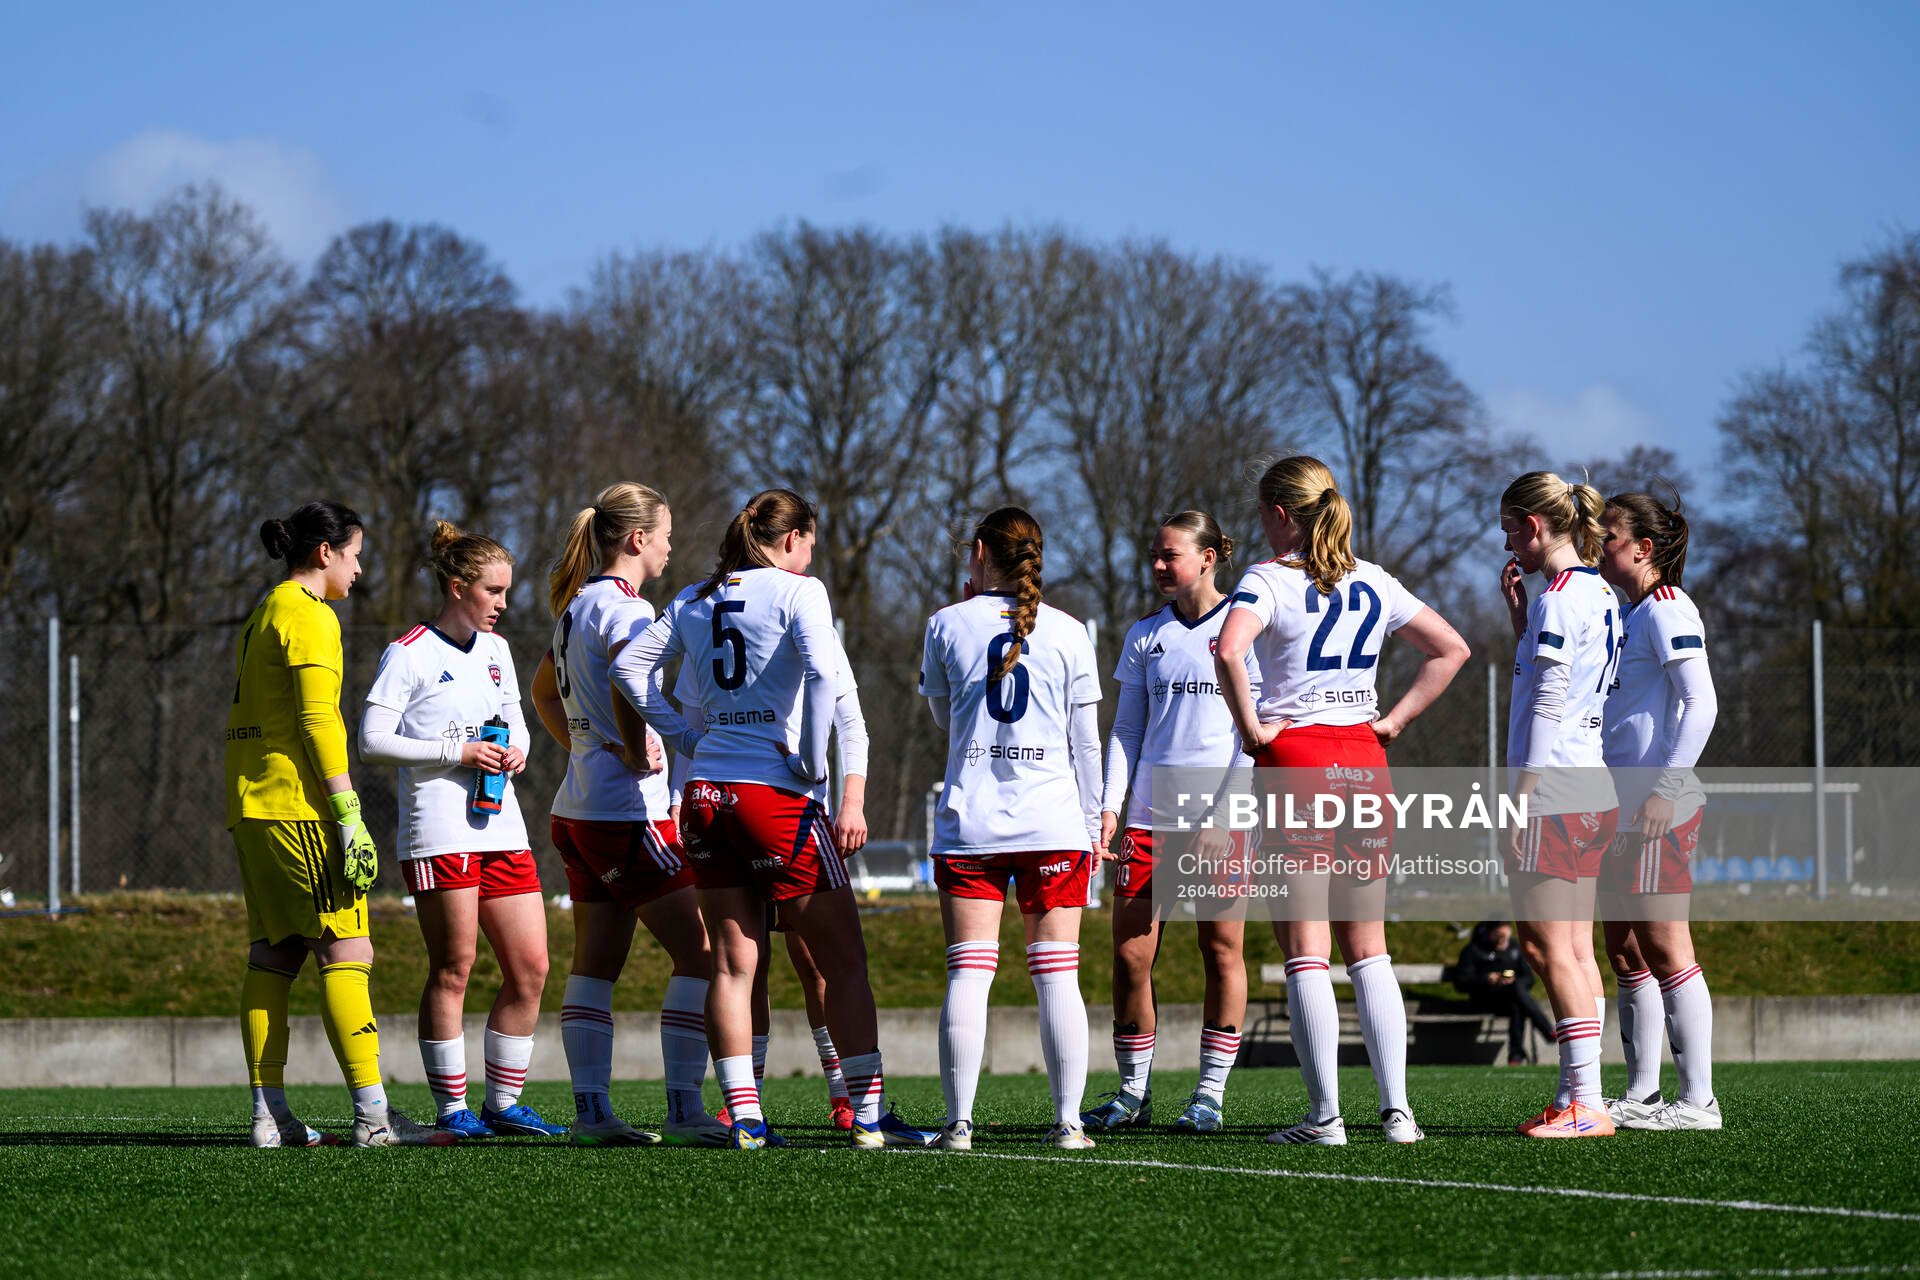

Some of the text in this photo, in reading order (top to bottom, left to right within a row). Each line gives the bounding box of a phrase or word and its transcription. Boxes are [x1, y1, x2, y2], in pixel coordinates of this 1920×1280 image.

[1305, 580, 1382, 672] 22
[712, 600, 747, 691] 5
[1595, 608, 1623, 696] 1
[232, 623, 254, 704] 1
[985, 632, 1030, 724] 6
[465, 726, 479, 738] SI
[1325, 763, 1364, 781] akea
[692, 784, 728, 804] akea
[1291, 833, 1325, 842] Scandic
[1361, 836, 1388, 849] RWE
[459, 853, 470, 873] 7
[752, 855, 784, 870] RWE
[1039, 860, 1072, 877] RWE
[354, 907, 361, 930] 1
